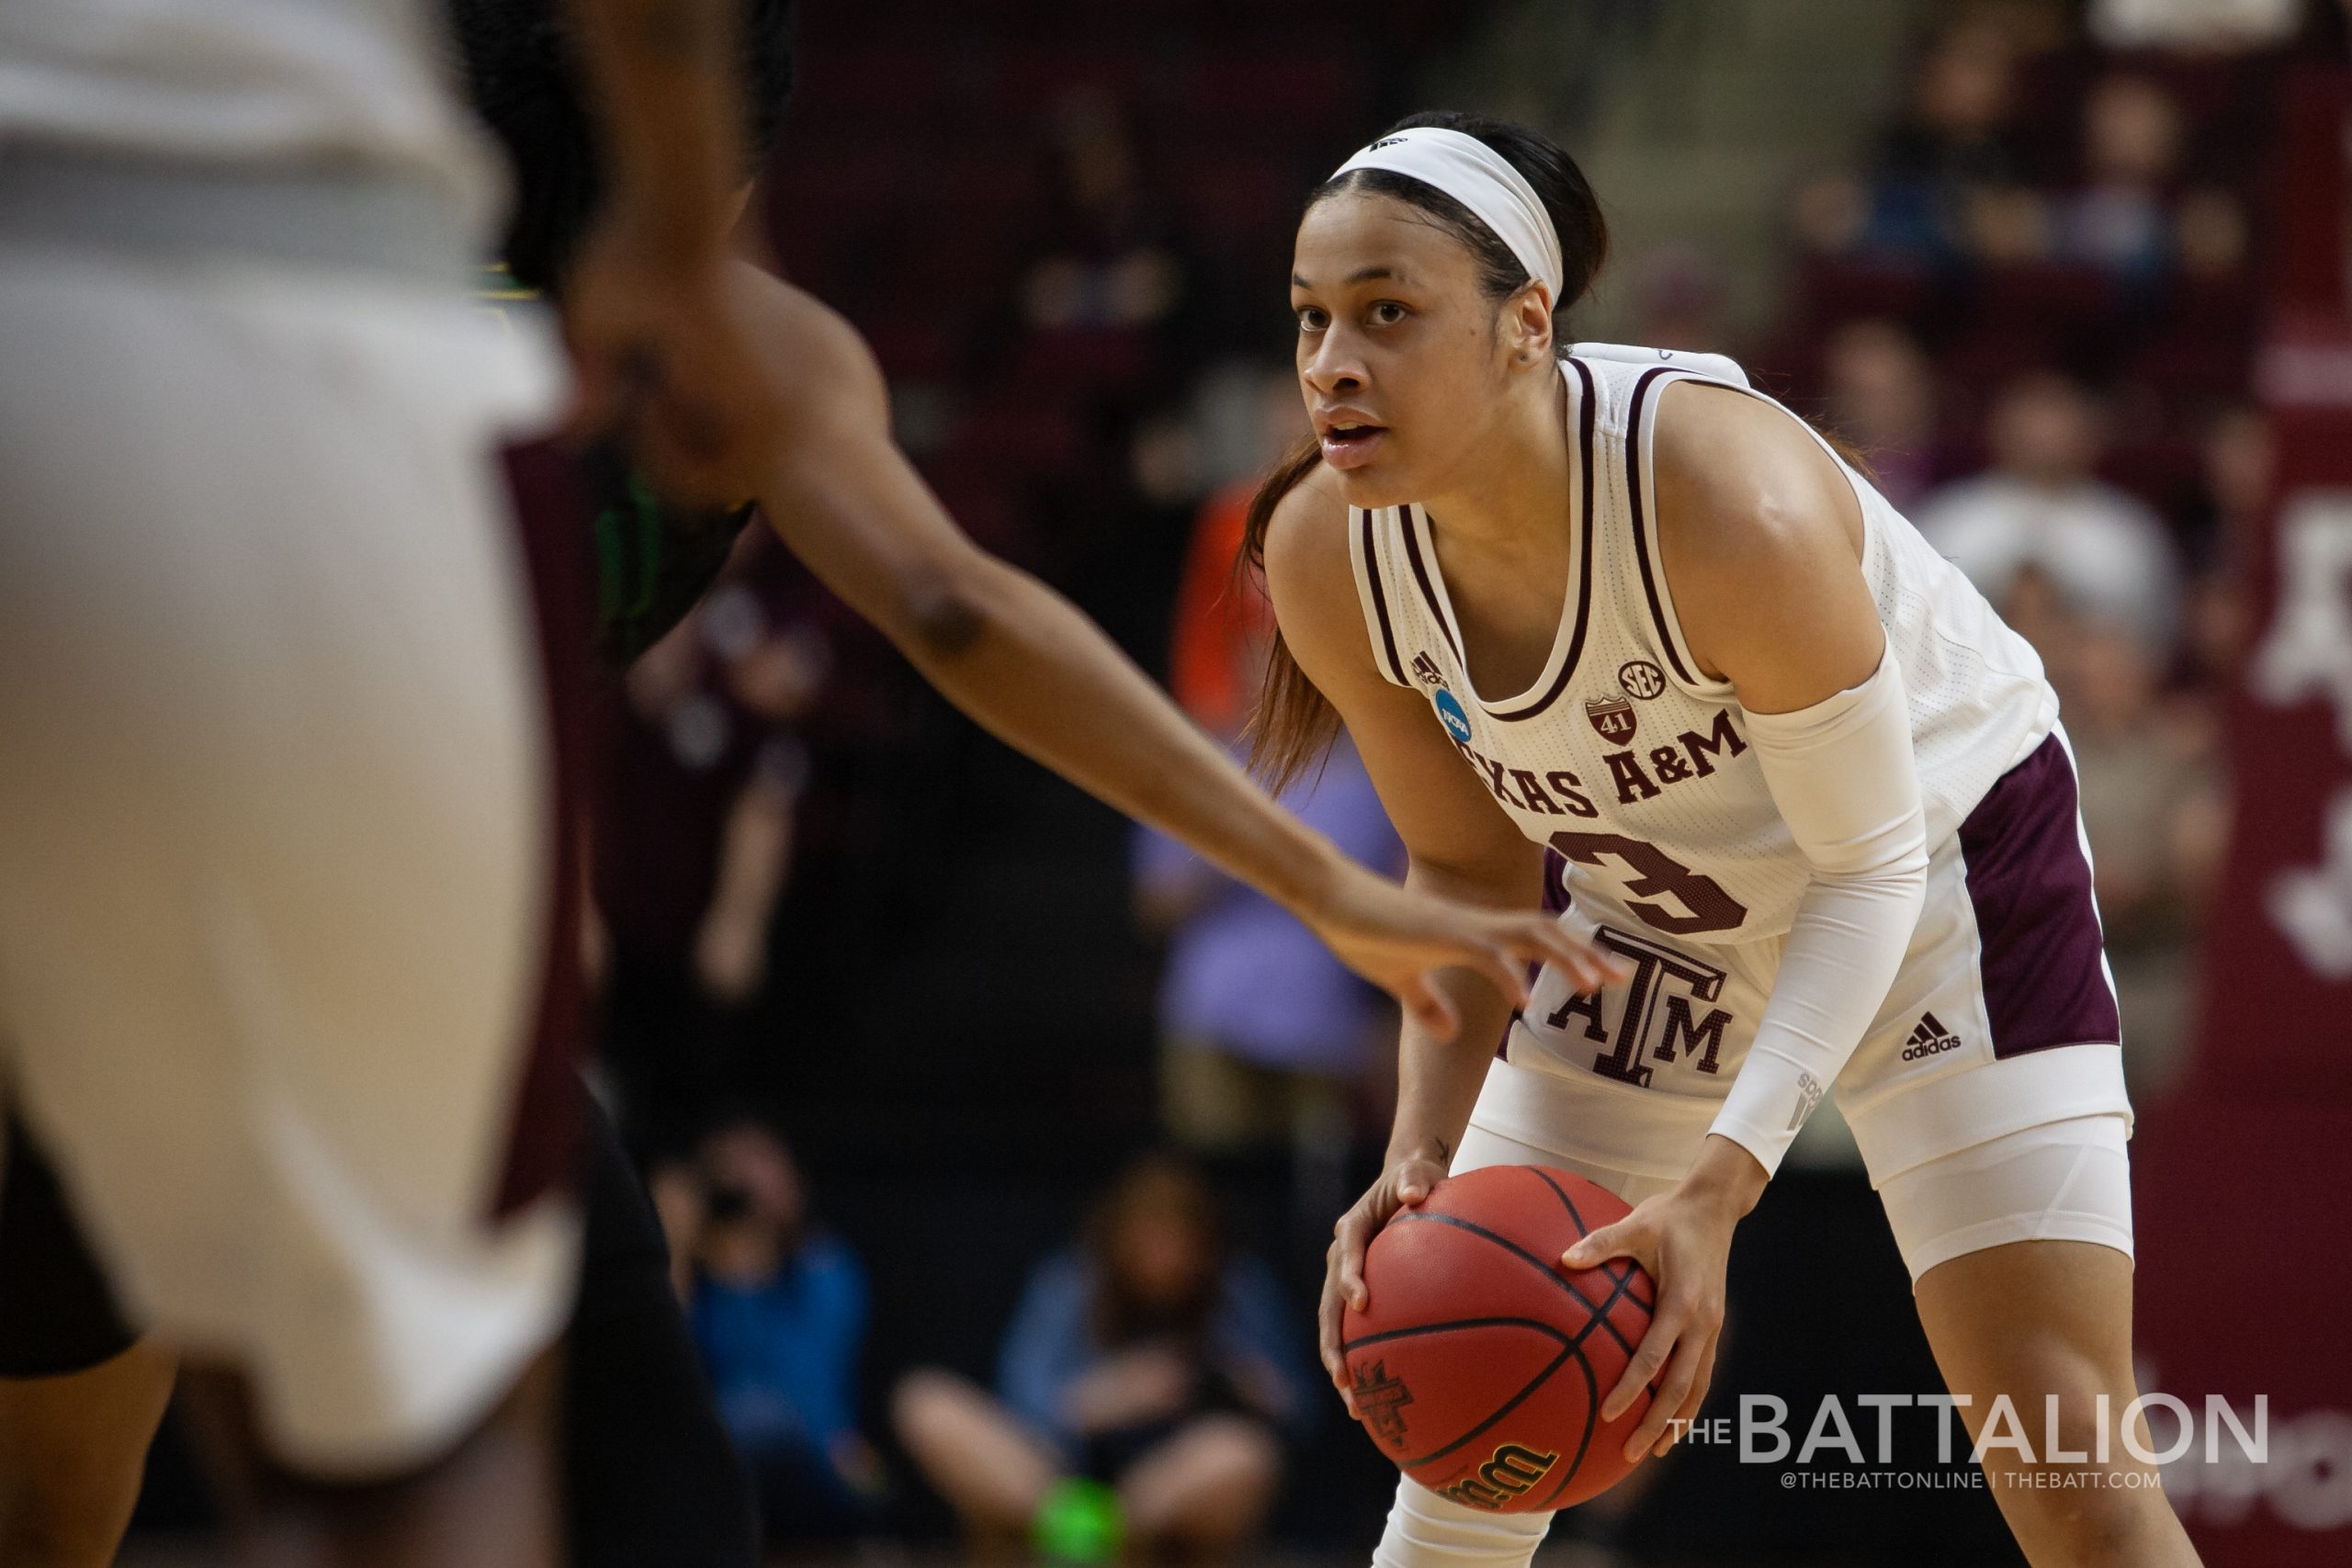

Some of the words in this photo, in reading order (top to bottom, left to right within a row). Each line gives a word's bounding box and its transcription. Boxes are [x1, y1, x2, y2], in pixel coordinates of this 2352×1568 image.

[1621, 663, 1663, 698] SEC
[1600, 712, 1632, 734] 41
[1454, 739, 1600, 818] EXAS
[1602, 708, 1748, 805] A&M
[1549, 830, 1748, 935] 3
[1902, 1035, 1962, 1062] adidas
